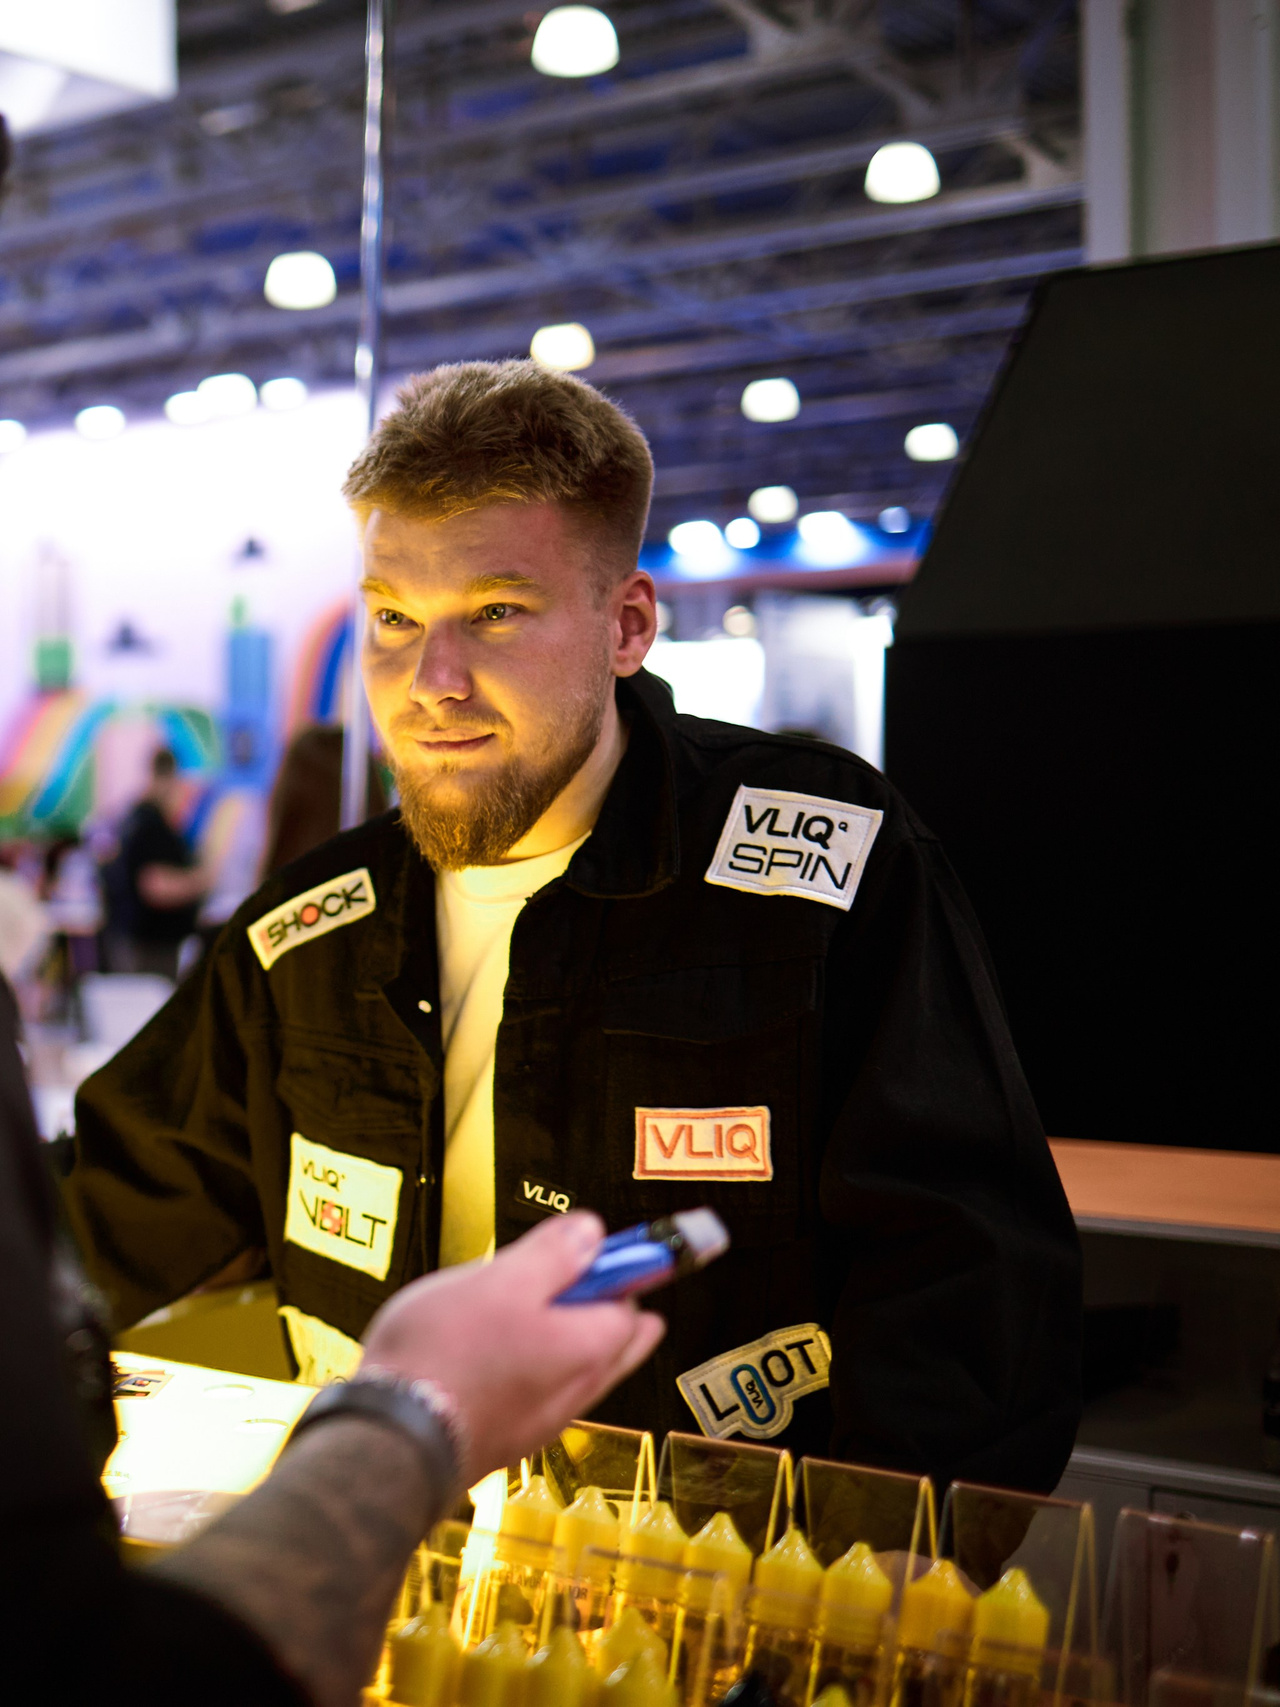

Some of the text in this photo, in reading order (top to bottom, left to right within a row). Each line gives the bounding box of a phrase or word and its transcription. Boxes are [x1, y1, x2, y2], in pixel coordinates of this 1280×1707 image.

[744, 804, 835, 850] VLIQ
[728, 842, 852, 890] SPIN
[267, 881, 368, 948] SHOCK
[650, 1123, 760, 1163] VLIQ
[299, 1190, 387, 1248] VOLT
[523, 1180, 570, 1214] VLIQ
[699, 1338, 817, 1425] LOOT
